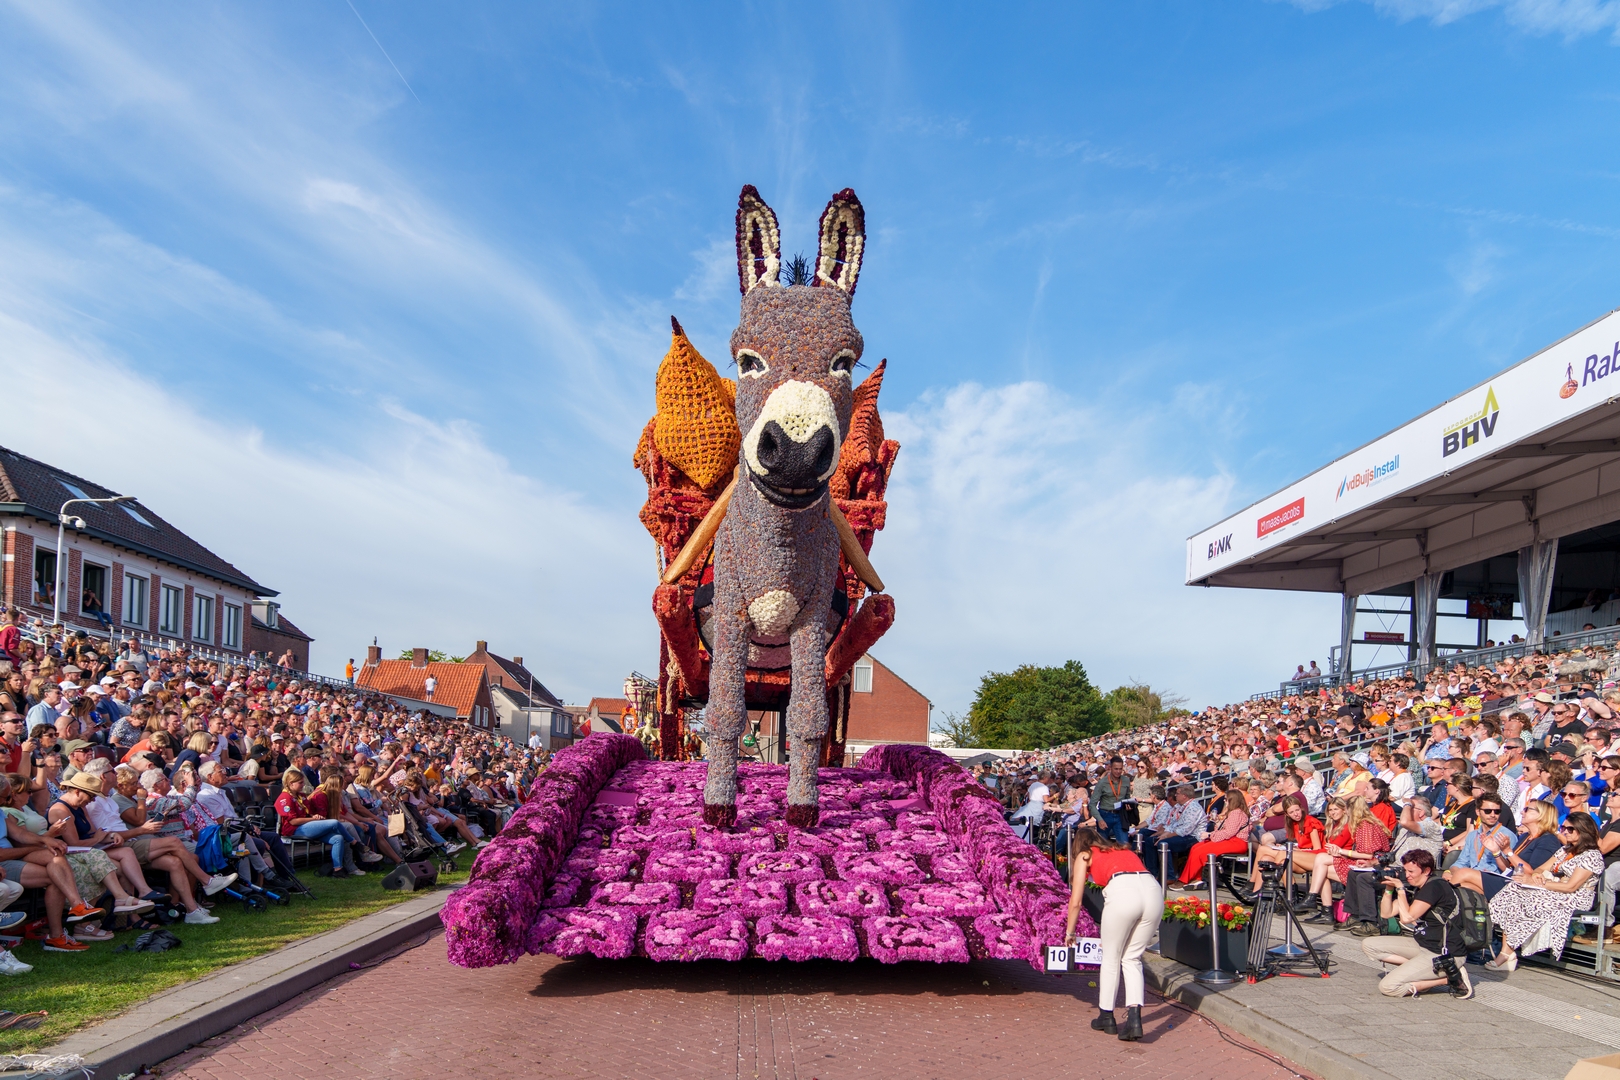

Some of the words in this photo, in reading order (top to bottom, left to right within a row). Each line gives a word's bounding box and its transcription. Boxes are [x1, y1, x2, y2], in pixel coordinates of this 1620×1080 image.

[1443, 410, 1482, 433] EXPOGROEP
[1443, 410, 1499, 458] BHV
[1050, 950, 1066, 962] 10
